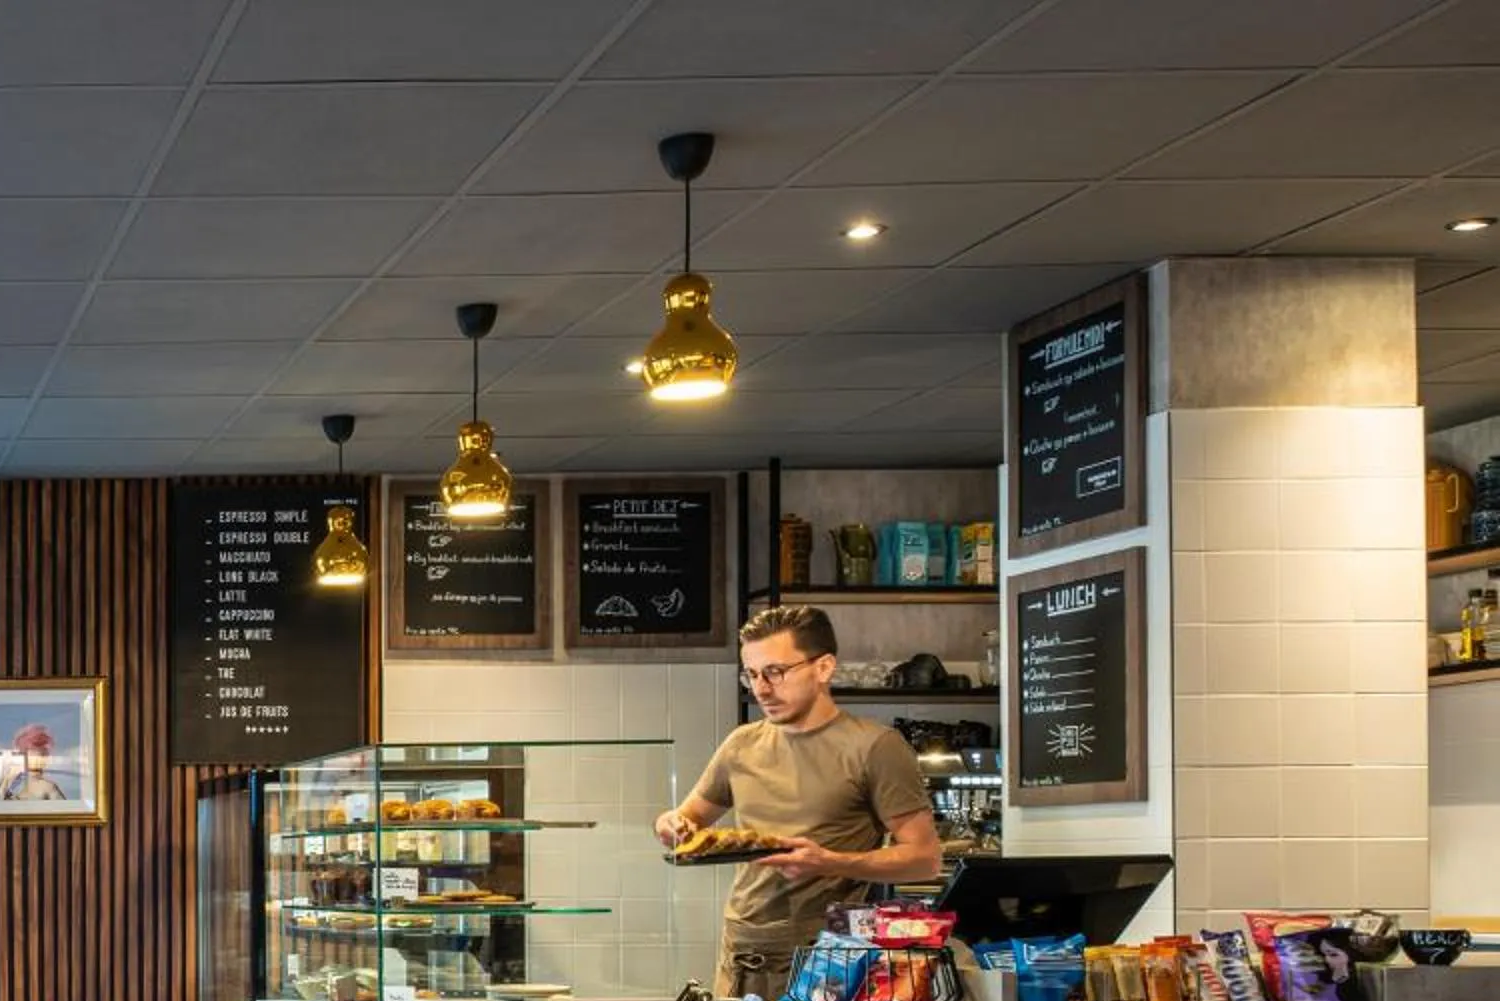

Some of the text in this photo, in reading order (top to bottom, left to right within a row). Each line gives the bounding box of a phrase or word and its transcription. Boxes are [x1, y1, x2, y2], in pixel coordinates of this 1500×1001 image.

[612, 499, 649, 513] PETIT
[218, 510, 309, 523] ESPRESSO SIMPLE
[218, 531, 310, 545] ESPRESSO DOUBLE
[218, 551, 271, 564] MACCHIATO
[218, 570, 279, 583] LONG BLACK
[218, 589, 247, 603] LATTE
[1045, 583, 1096, 611] LUNCH
[218, 609, 275, 621] CAPPUCCINO
[218, 628, 273, 641] FLAT WHITE
[218, 647, 251, 660] MOCHA
[218, 685, 266, 699] CHOCOLAT
[219, 705, 289, 718] JUS DE FRUITS
